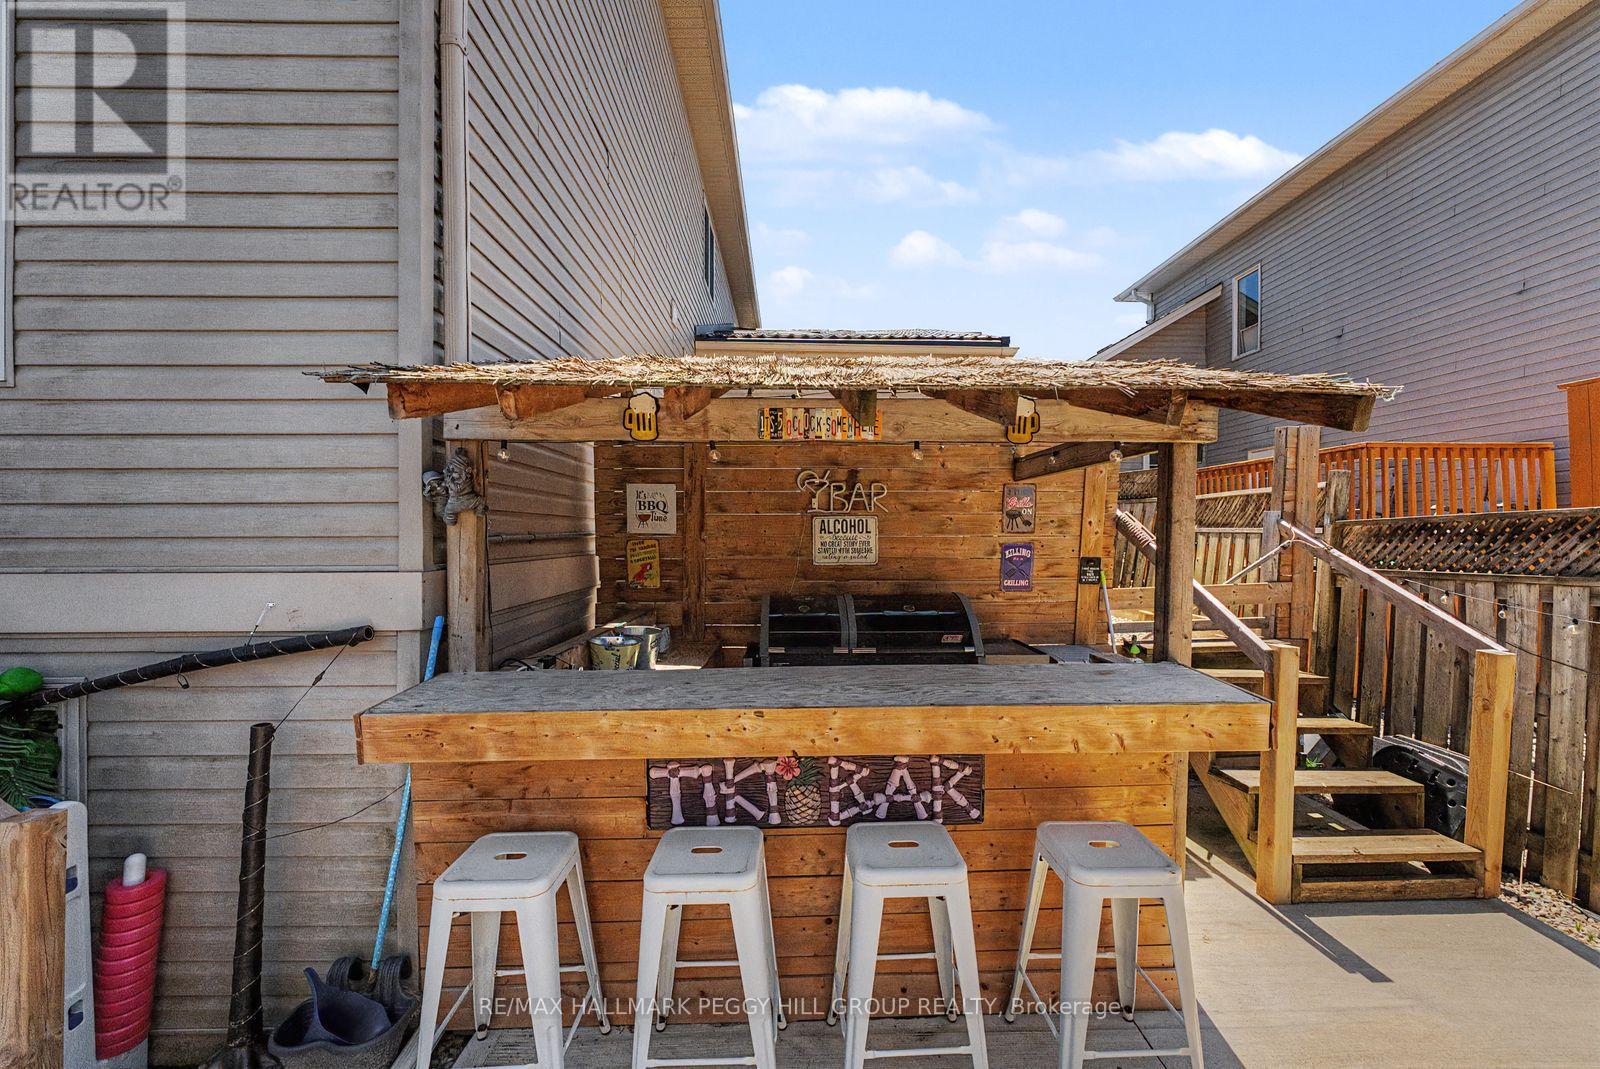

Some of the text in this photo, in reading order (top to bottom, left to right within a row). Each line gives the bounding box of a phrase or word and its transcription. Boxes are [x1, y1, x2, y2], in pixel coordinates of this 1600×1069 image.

[635, 490, 647, 499] It's
[830, 482, 888, 513] BAR
[638, 500, 668, 514] BBQ
[650, 511, 668, 522] Time
[819, 519, 871, 534] ALCOHOL
[1003, 579, 1029, 587] GRILLING
[649, 755, 980, 826] TIKI BAR
